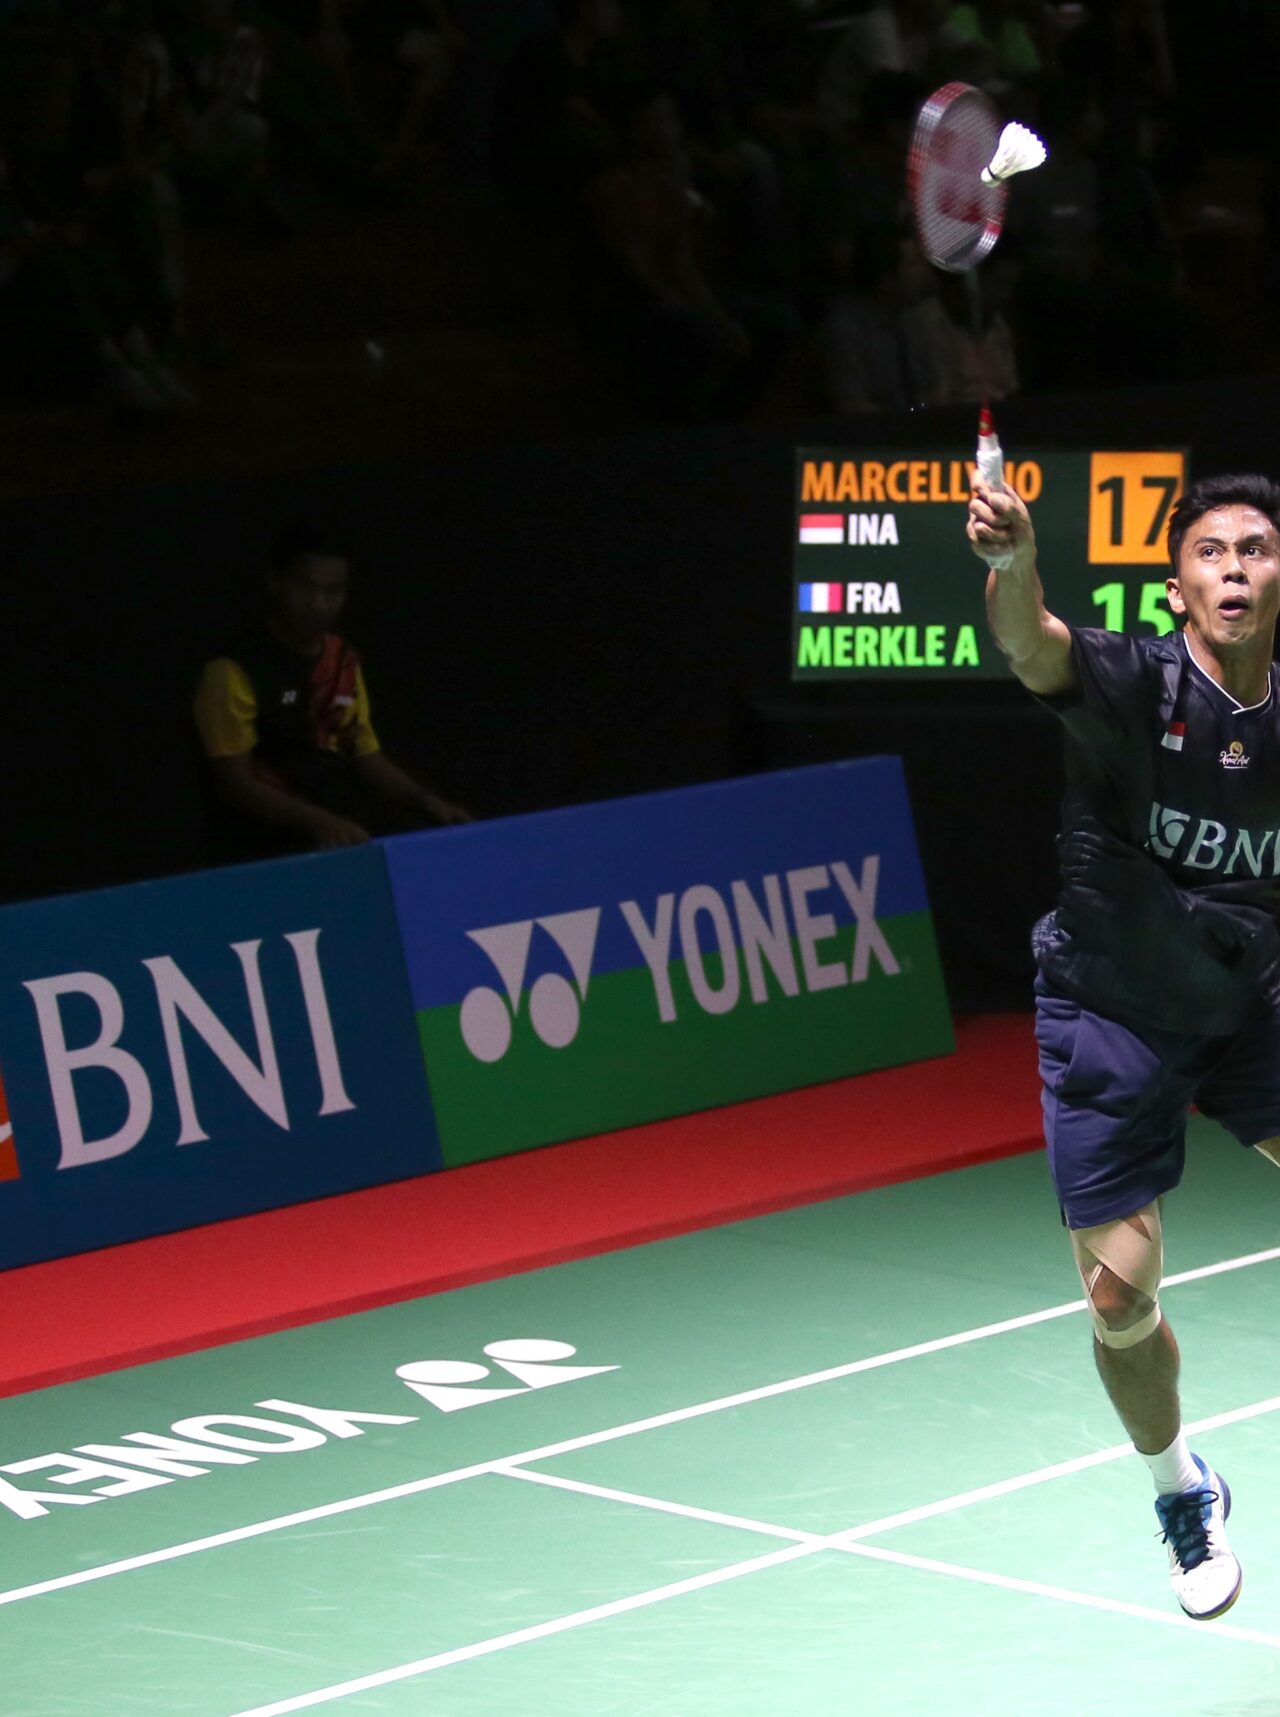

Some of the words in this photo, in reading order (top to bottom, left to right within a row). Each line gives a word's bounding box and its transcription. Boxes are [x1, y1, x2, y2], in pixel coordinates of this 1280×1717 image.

[847, 514, 899, 545] INA
[1098, 476, 1178, 546] 17
[846, 582, 901, 614] FRA
[1091, 582, 1176, 637] 15
[798, 626, 946, 667] MERKLE
[952, 626, 980, 666] A
[619, 854, 902, 1025] YONEX
[22, 928, 357, 1172] BNI
